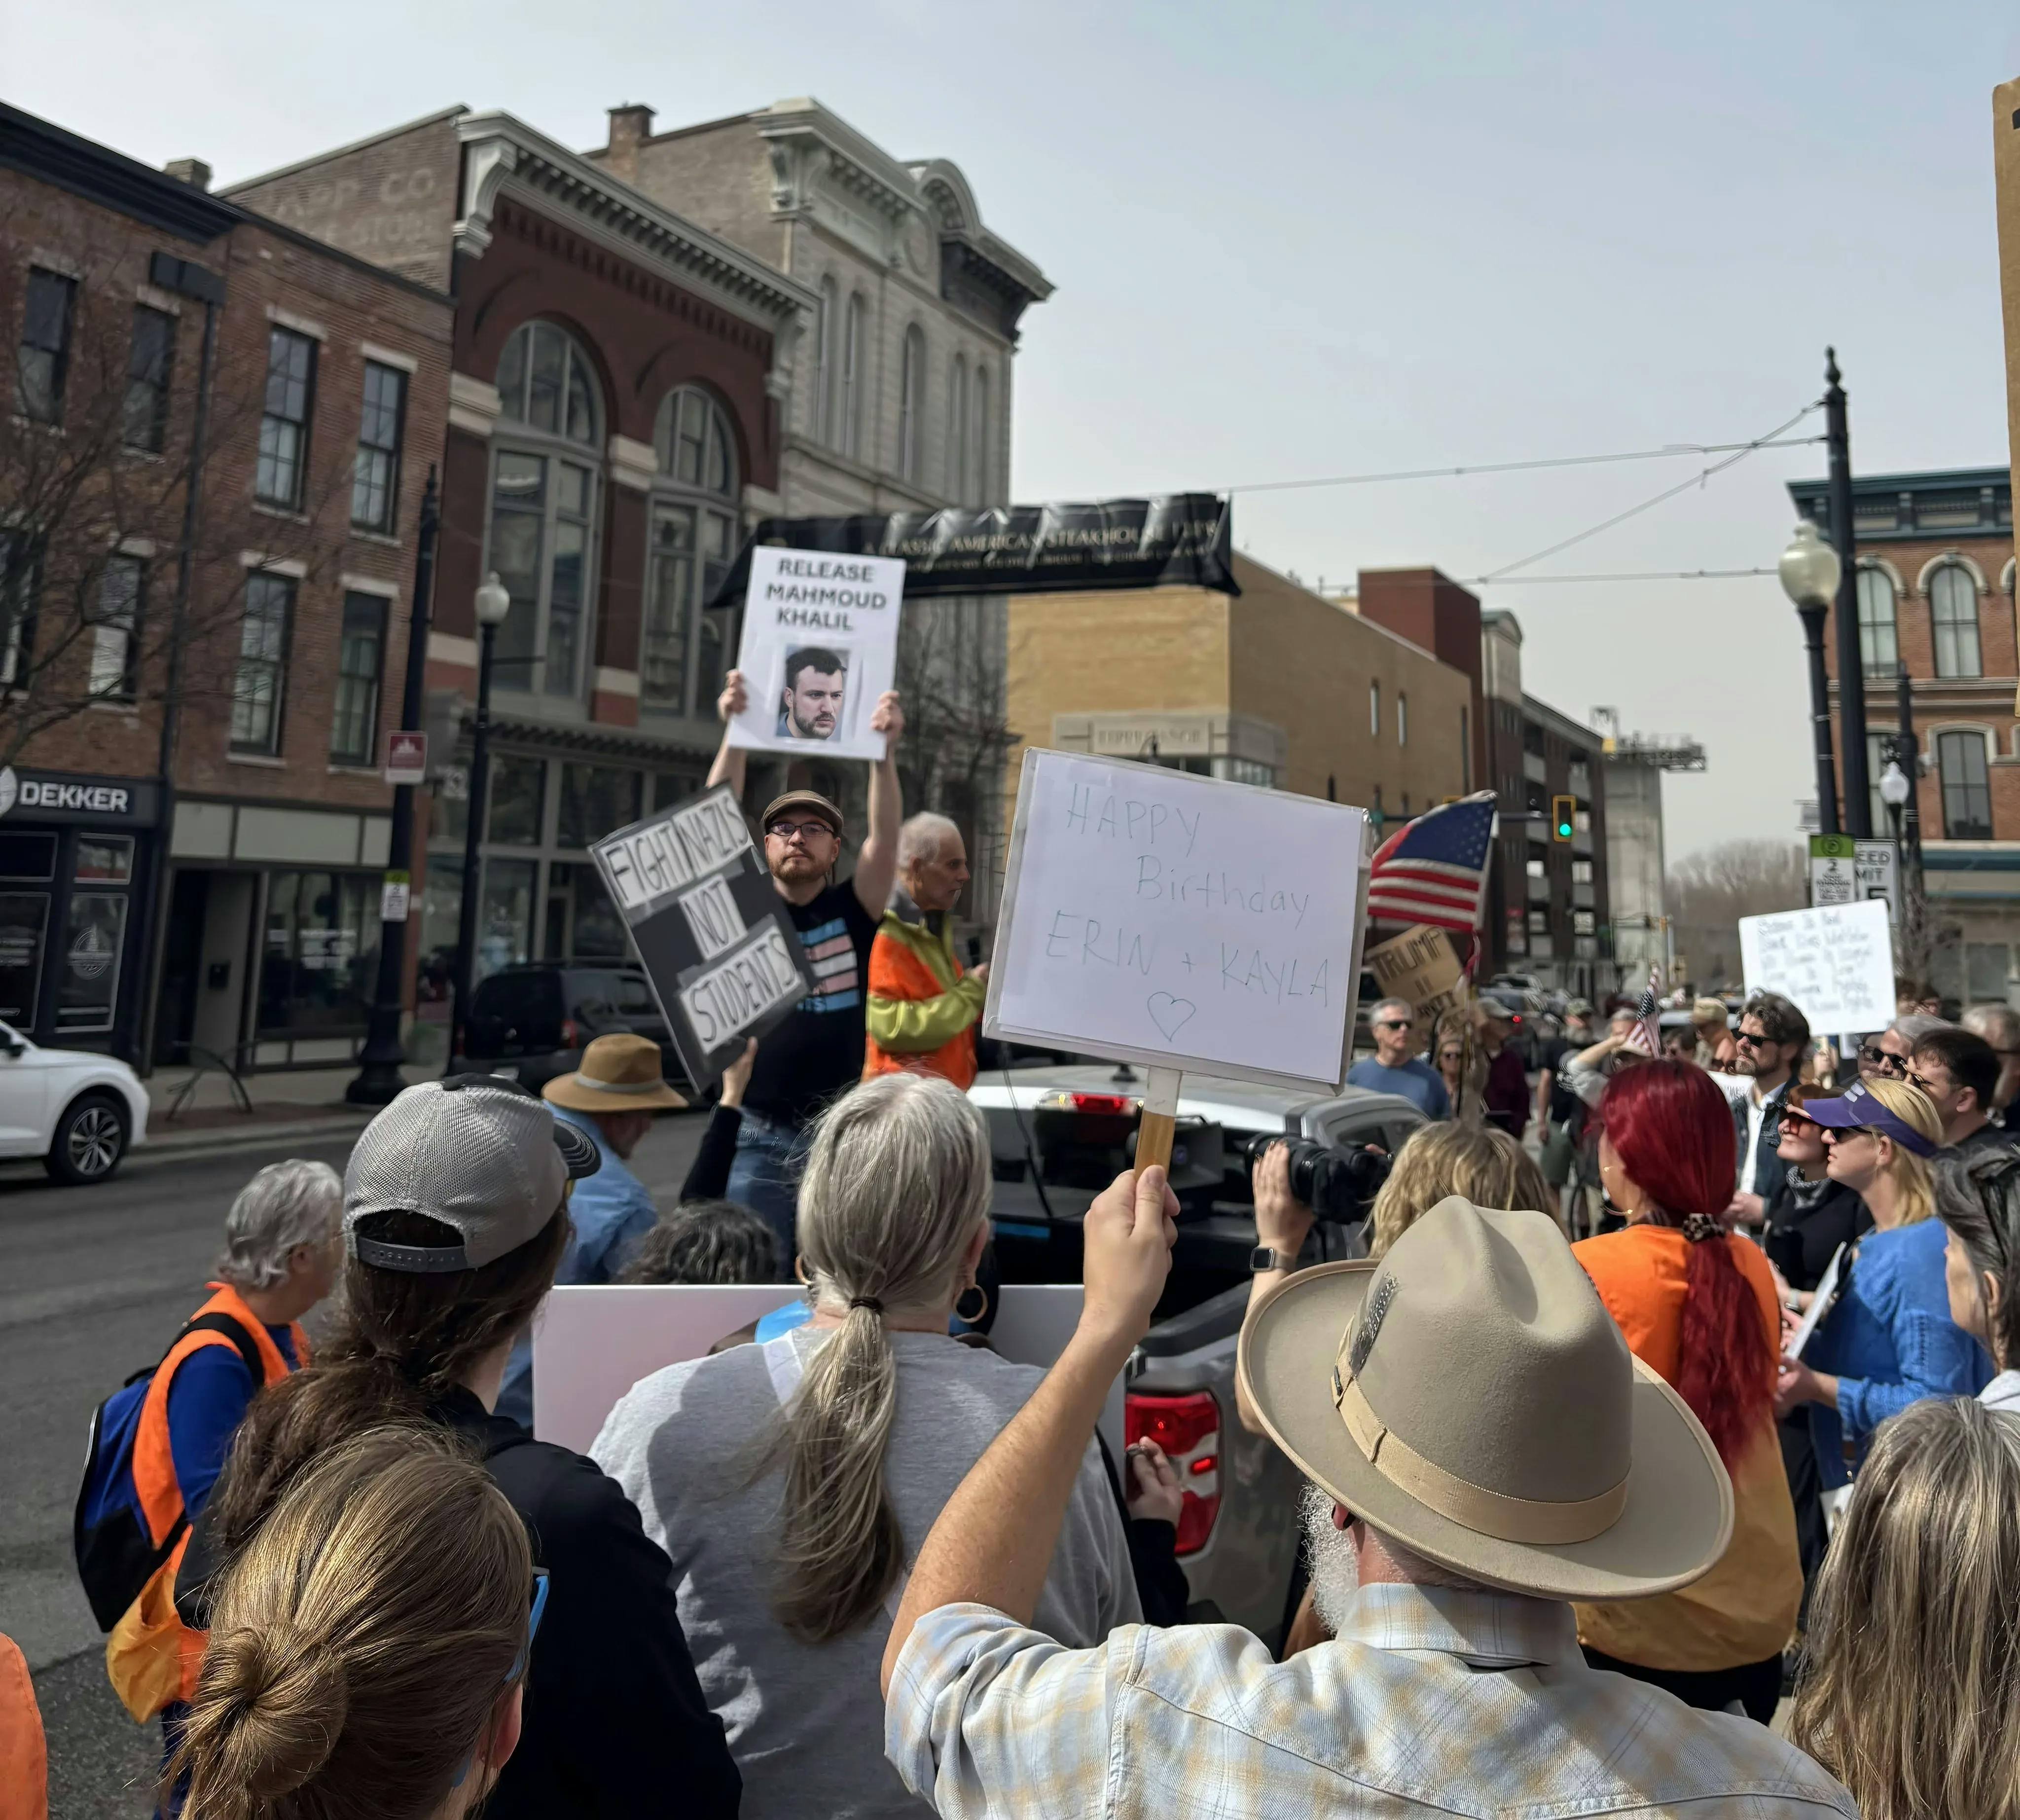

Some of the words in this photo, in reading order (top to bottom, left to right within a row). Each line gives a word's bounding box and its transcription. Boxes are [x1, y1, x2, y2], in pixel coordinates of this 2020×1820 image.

[765, 582, 887, 610] MAHMOUD
[777, 558, 874, 583] RELEASE
[776, 607, 854, 631] KHALIL
[20, 781, 129, 813] DEKKER
[1067, 783, 1200, 857] HAPPY
[606, 825, 689, 903] FIGHT
[678, 795, 750, 872] NAZIS
[1855, 850, 1891, 865] EED
[684, 880, 741, 955] NOT
[1137, 855, 1309, 930] Birthday
[1046, 910, 1156, 975] ERIN
[1222, 942, 1328, 1007] KAYLA
[1370, 926, 1441, 983] TRUMP
[690, 933, 796, 1042] STUDENTS
